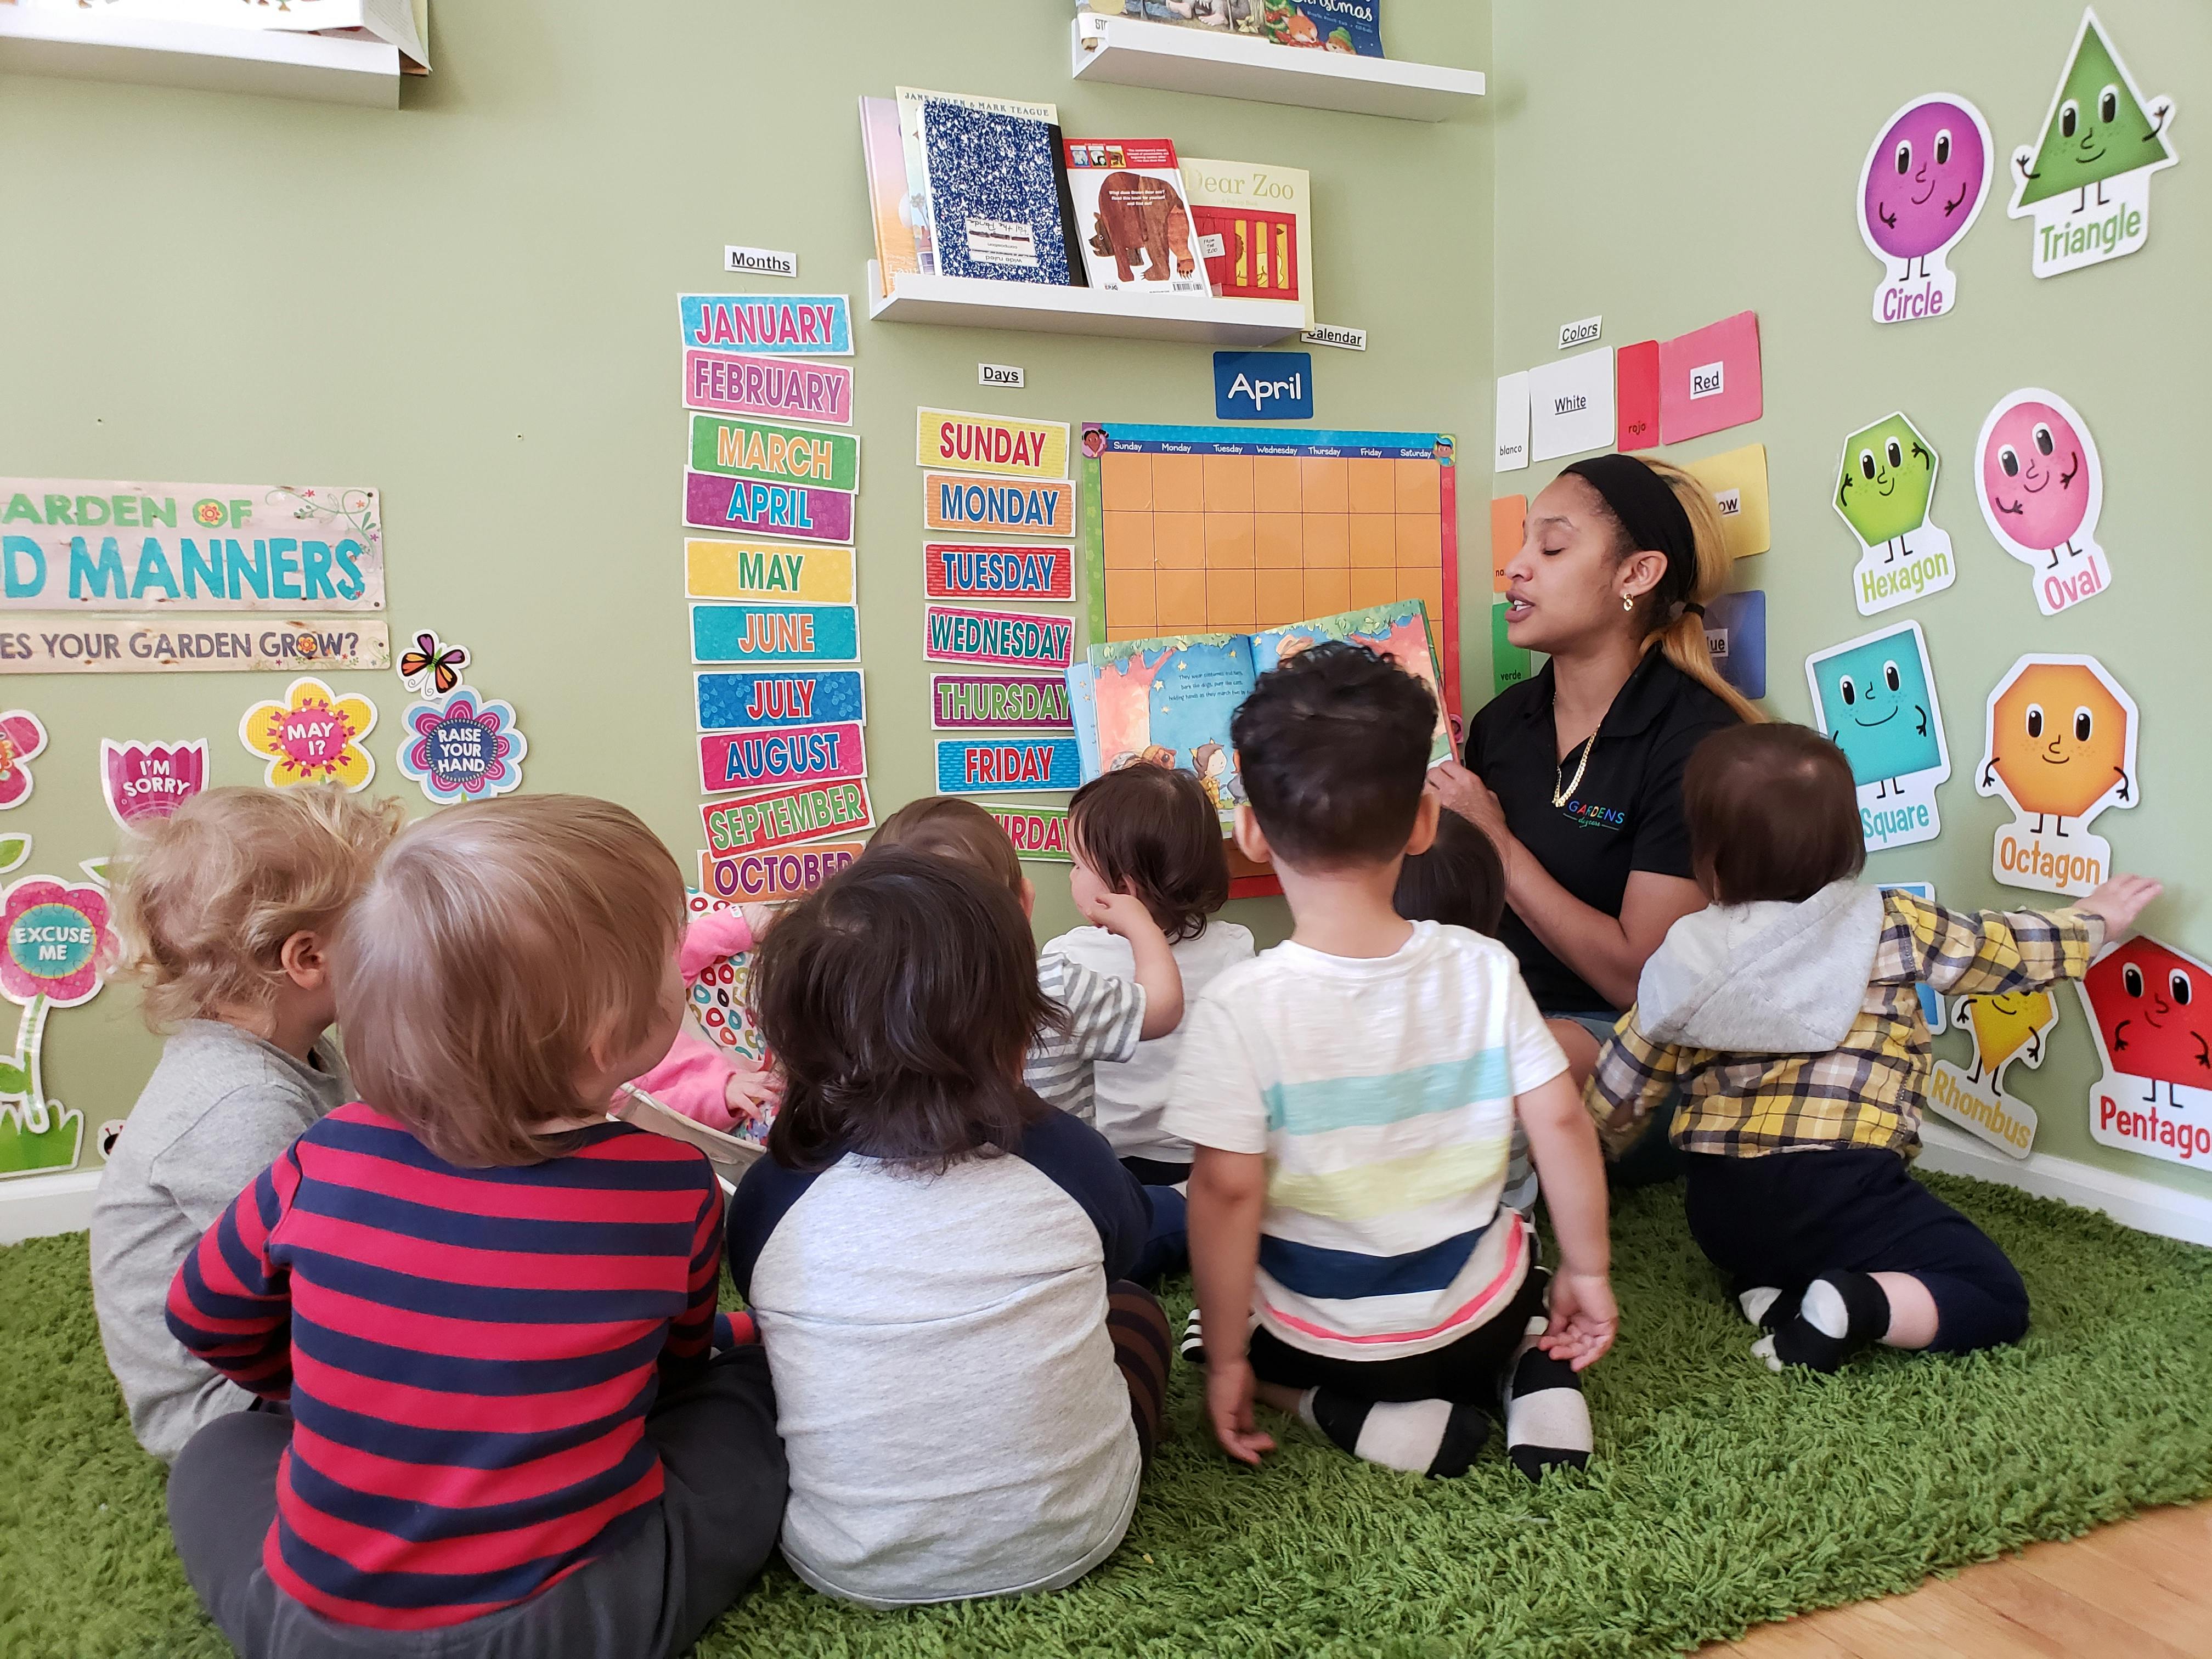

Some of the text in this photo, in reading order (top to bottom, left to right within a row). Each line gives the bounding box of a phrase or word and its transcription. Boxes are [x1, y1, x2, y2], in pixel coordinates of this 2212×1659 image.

[978, 101, 1006, 112] MARK
[1010, 106, 1049, 116] TEAGUE
[1182, 167, 1294, 200] Dear Zoo
[998, 222, 1013, 232] the
[2040, 202, 2141, 263] Triangle
[731, 251, 791, 272] Months
[987, 242, 1018, 250] composition
[1883, 281, 1943, 321] Circle
[695, 304, 834, 344] JANUARY
[1561, 321, 1598, 343] Colors
[695, 358, 844, 414] FEBRUARY
[983, 366, 1019, 383] Days
[1228, 372, 1302, 411] April
[1693, 371, 1720, 391] Red
[1554, 394, 1587, 413] White
[939, 422, 1046, 467] SUNDAY
[1628, 422, 1646, 436] rojo
[717, 426, 832, 479] MARCH
[1113, 442, 1432, 458] Sunday Monday Tuesday Wednesday Thursday Friday Saturday
[1499, 444, 1522, 456] blanco
[193, 498, 252, 529] OF
[726, 482, 813, 529] APRIL
[941, 483, 1059, 526] MONDAY
[69, 535, 366, 601] MANNERS
[738, 551, 805, 592] MAY
[942, 551, 1056, 591] TUESDAY
[1861, 552, 1949, 603] Hexagon
[2044, 556, 2101, 610] Oval
[40, 633, 122, 658] YOUR
[129, 633, 252, 658] GARDEN
[259, 632, 359, 657] GROW?
[738, 613, 815, 652] JUNE
[930, 613, 1069, 661] WEDNESDAY
[1500, 669, 1521, 681] verde
[747, 679, 816, 719] JULY
[938, 683, 1070, 720] THURSDAY
[287, 721, 334, 742] MAY
[308, 739, 326, 756] I?
[438, 728, 482, 743] RAISE
[437, 758, 486, 773] HAND
[439, 743, 482, 758] YOUR
[725, 732, 839, 781] AUGUST
[964, 746, 1054, 784] FRIDAY
[139, 760, 171, 777] I'M
[122, 777, 191, 797] SORRY
[709, 784, 866, 850] SEPTEMBER
[1568, 800, 1625, 823] GARDENS
[1860, 803, 1929, 843] Square
[2000, 836, 2100, 888] Octagon
[14, 926, 92, 944] EXCUSE
[38, 944, 67, 961] ME
[1931, 1067, 2030, 1150] Rhombus
[2100, 1095, 2211, 1159] Pentago
